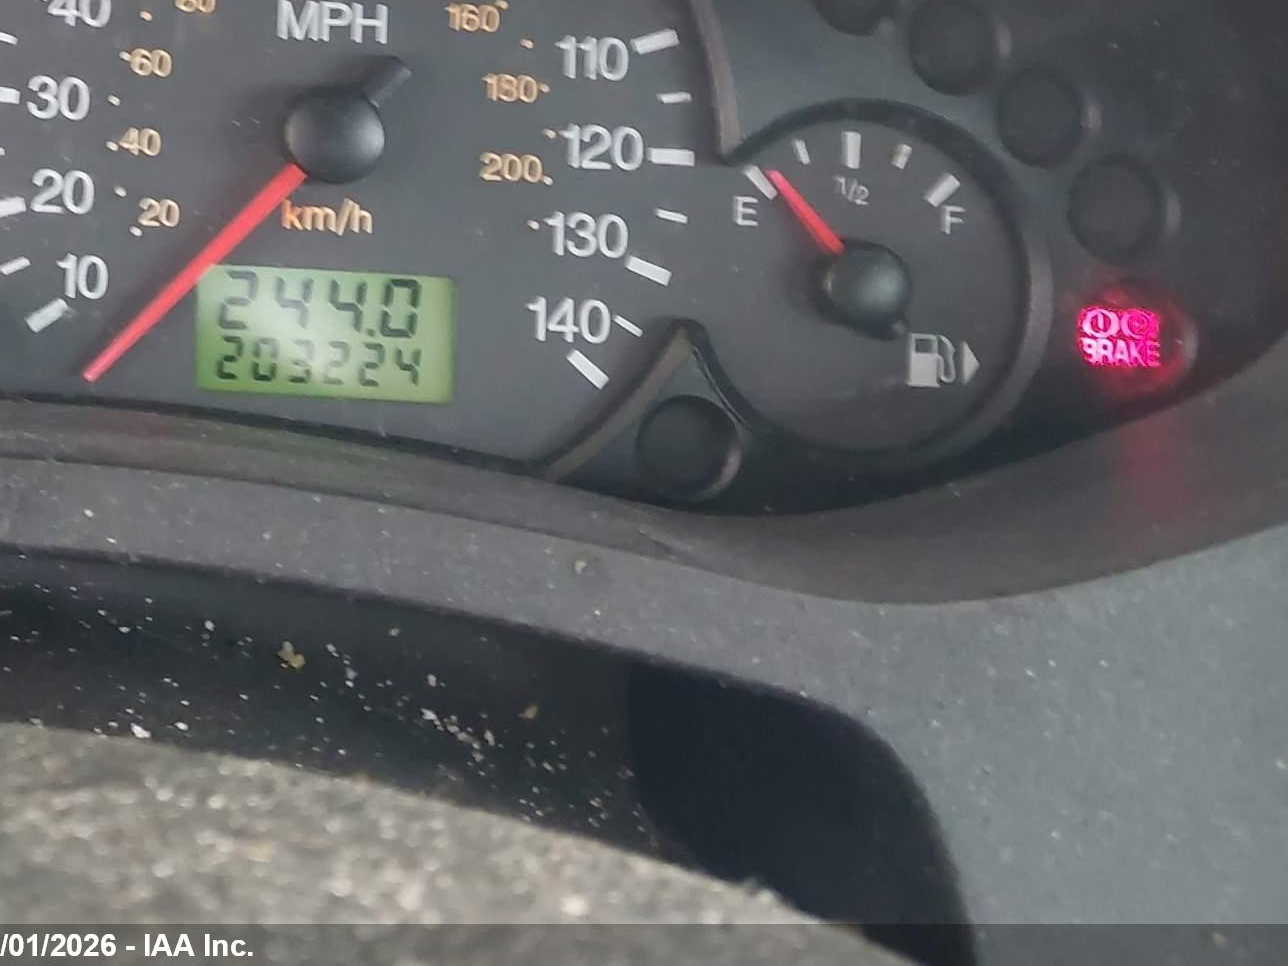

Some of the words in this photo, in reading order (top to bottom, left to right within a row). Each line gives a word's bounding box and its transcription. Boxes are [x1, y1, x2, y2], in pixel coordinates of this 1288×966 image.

[277, 0, 388, 45] MPH
[445, 2, 498, 31] 160
[128, 48, 170, 76] 60
[555, 38, 630, 81] 110
[26, 77, 90, 121] 30
[482, 73, 536, 101] 180
[119, 127, 161, 155] 40
[560, 124, 643, 169] 120
[479, 152, 541, 180] 200
[29, 169, 94, 214] 20
[733, 196, 758, 226] E
[138, 199, 179, 227] 20
[281, 200, 372, 235] km/h
[940, 205, 965, 234] F
[544, 211, 628, 257] 130
[57, 254, 108, 300] 10
[218, 270, 421, 338] 244.0
[527, 296, 610, 343] 140
[216, 338, 420, 386] 203224
[1081, 338, 1160, 367] BRAKE
